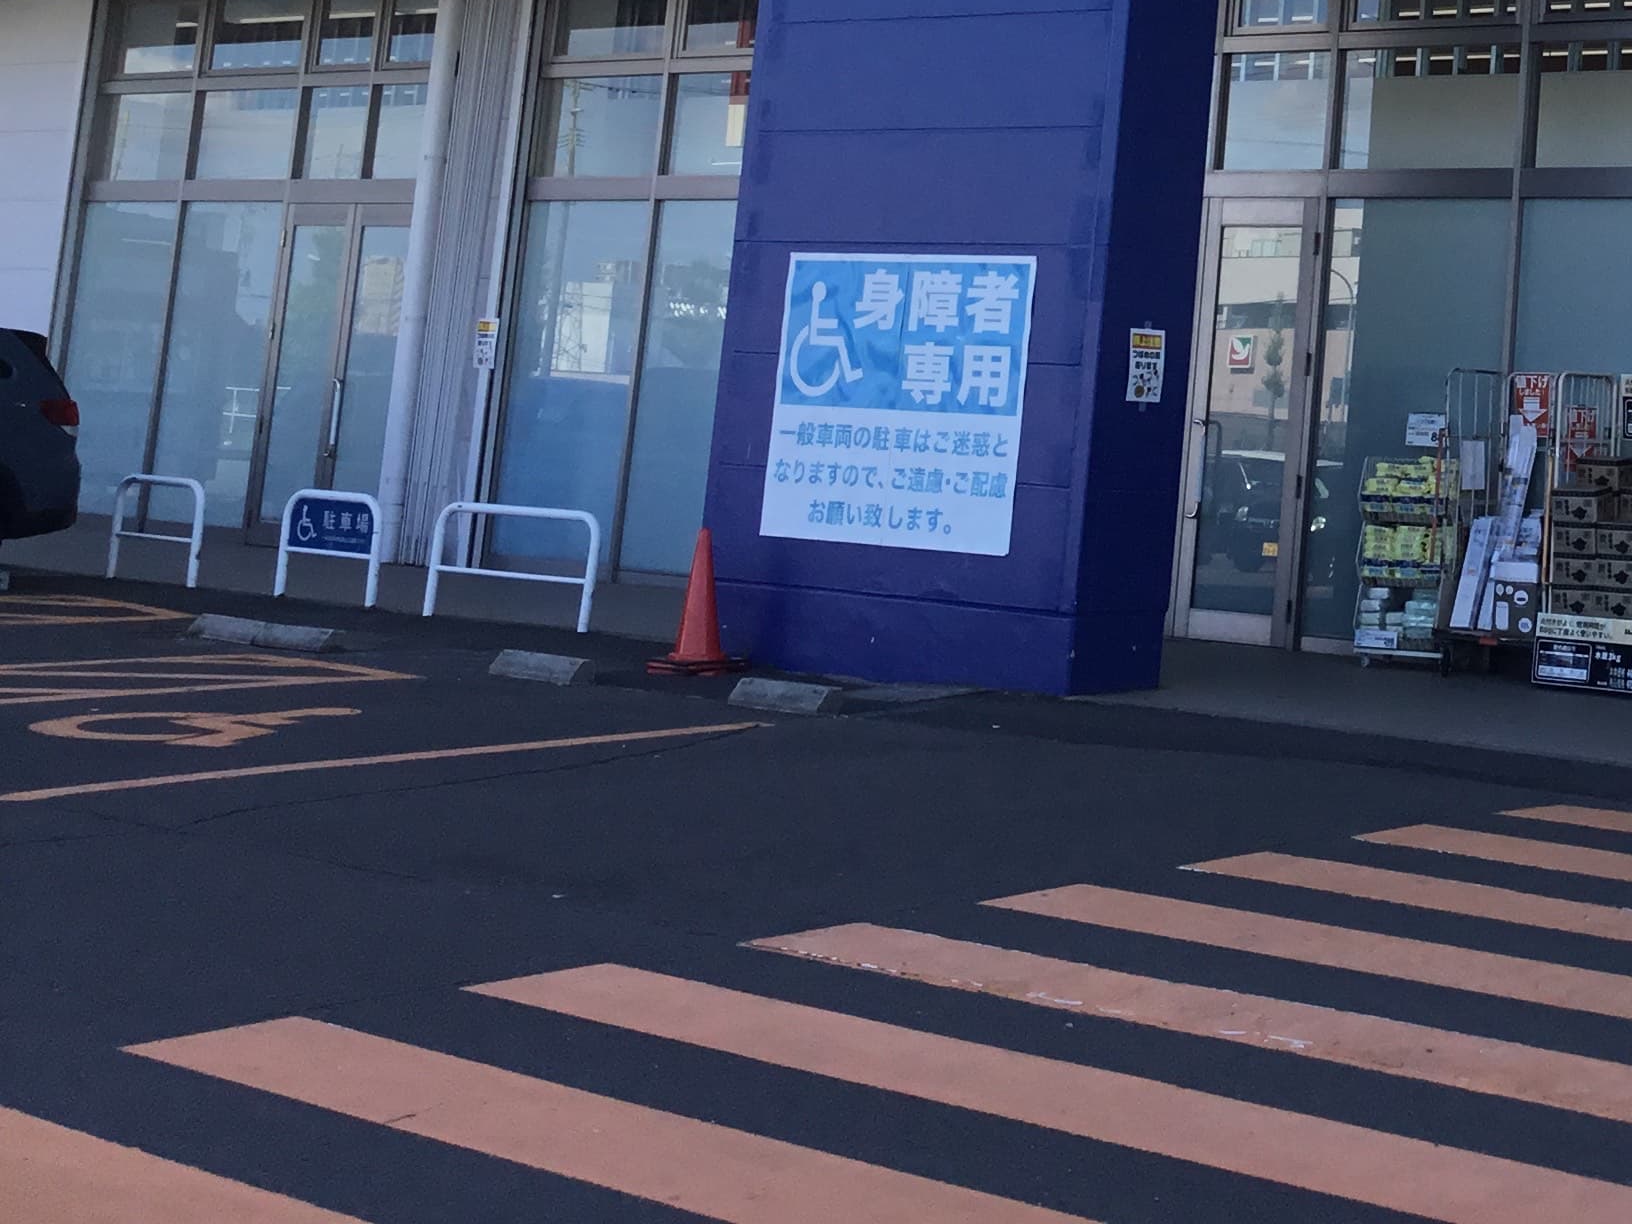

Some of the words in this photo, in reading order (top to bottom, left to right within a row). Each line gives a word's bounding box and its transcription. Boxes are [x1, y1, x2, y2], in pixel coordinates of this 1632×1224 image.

[853, 269, 1019, 336] 身障者
[901, 342, 1012, 408] 専用
[780, 422, 1009, 458] 一般車両の駐車はご迷惑と
[773, 458, 1009, 499] なりますので、ご遠慮・ご配慮
[322, 510, 369, 534] 駐車場
[807, 499, 952, 535] お願い致します。
